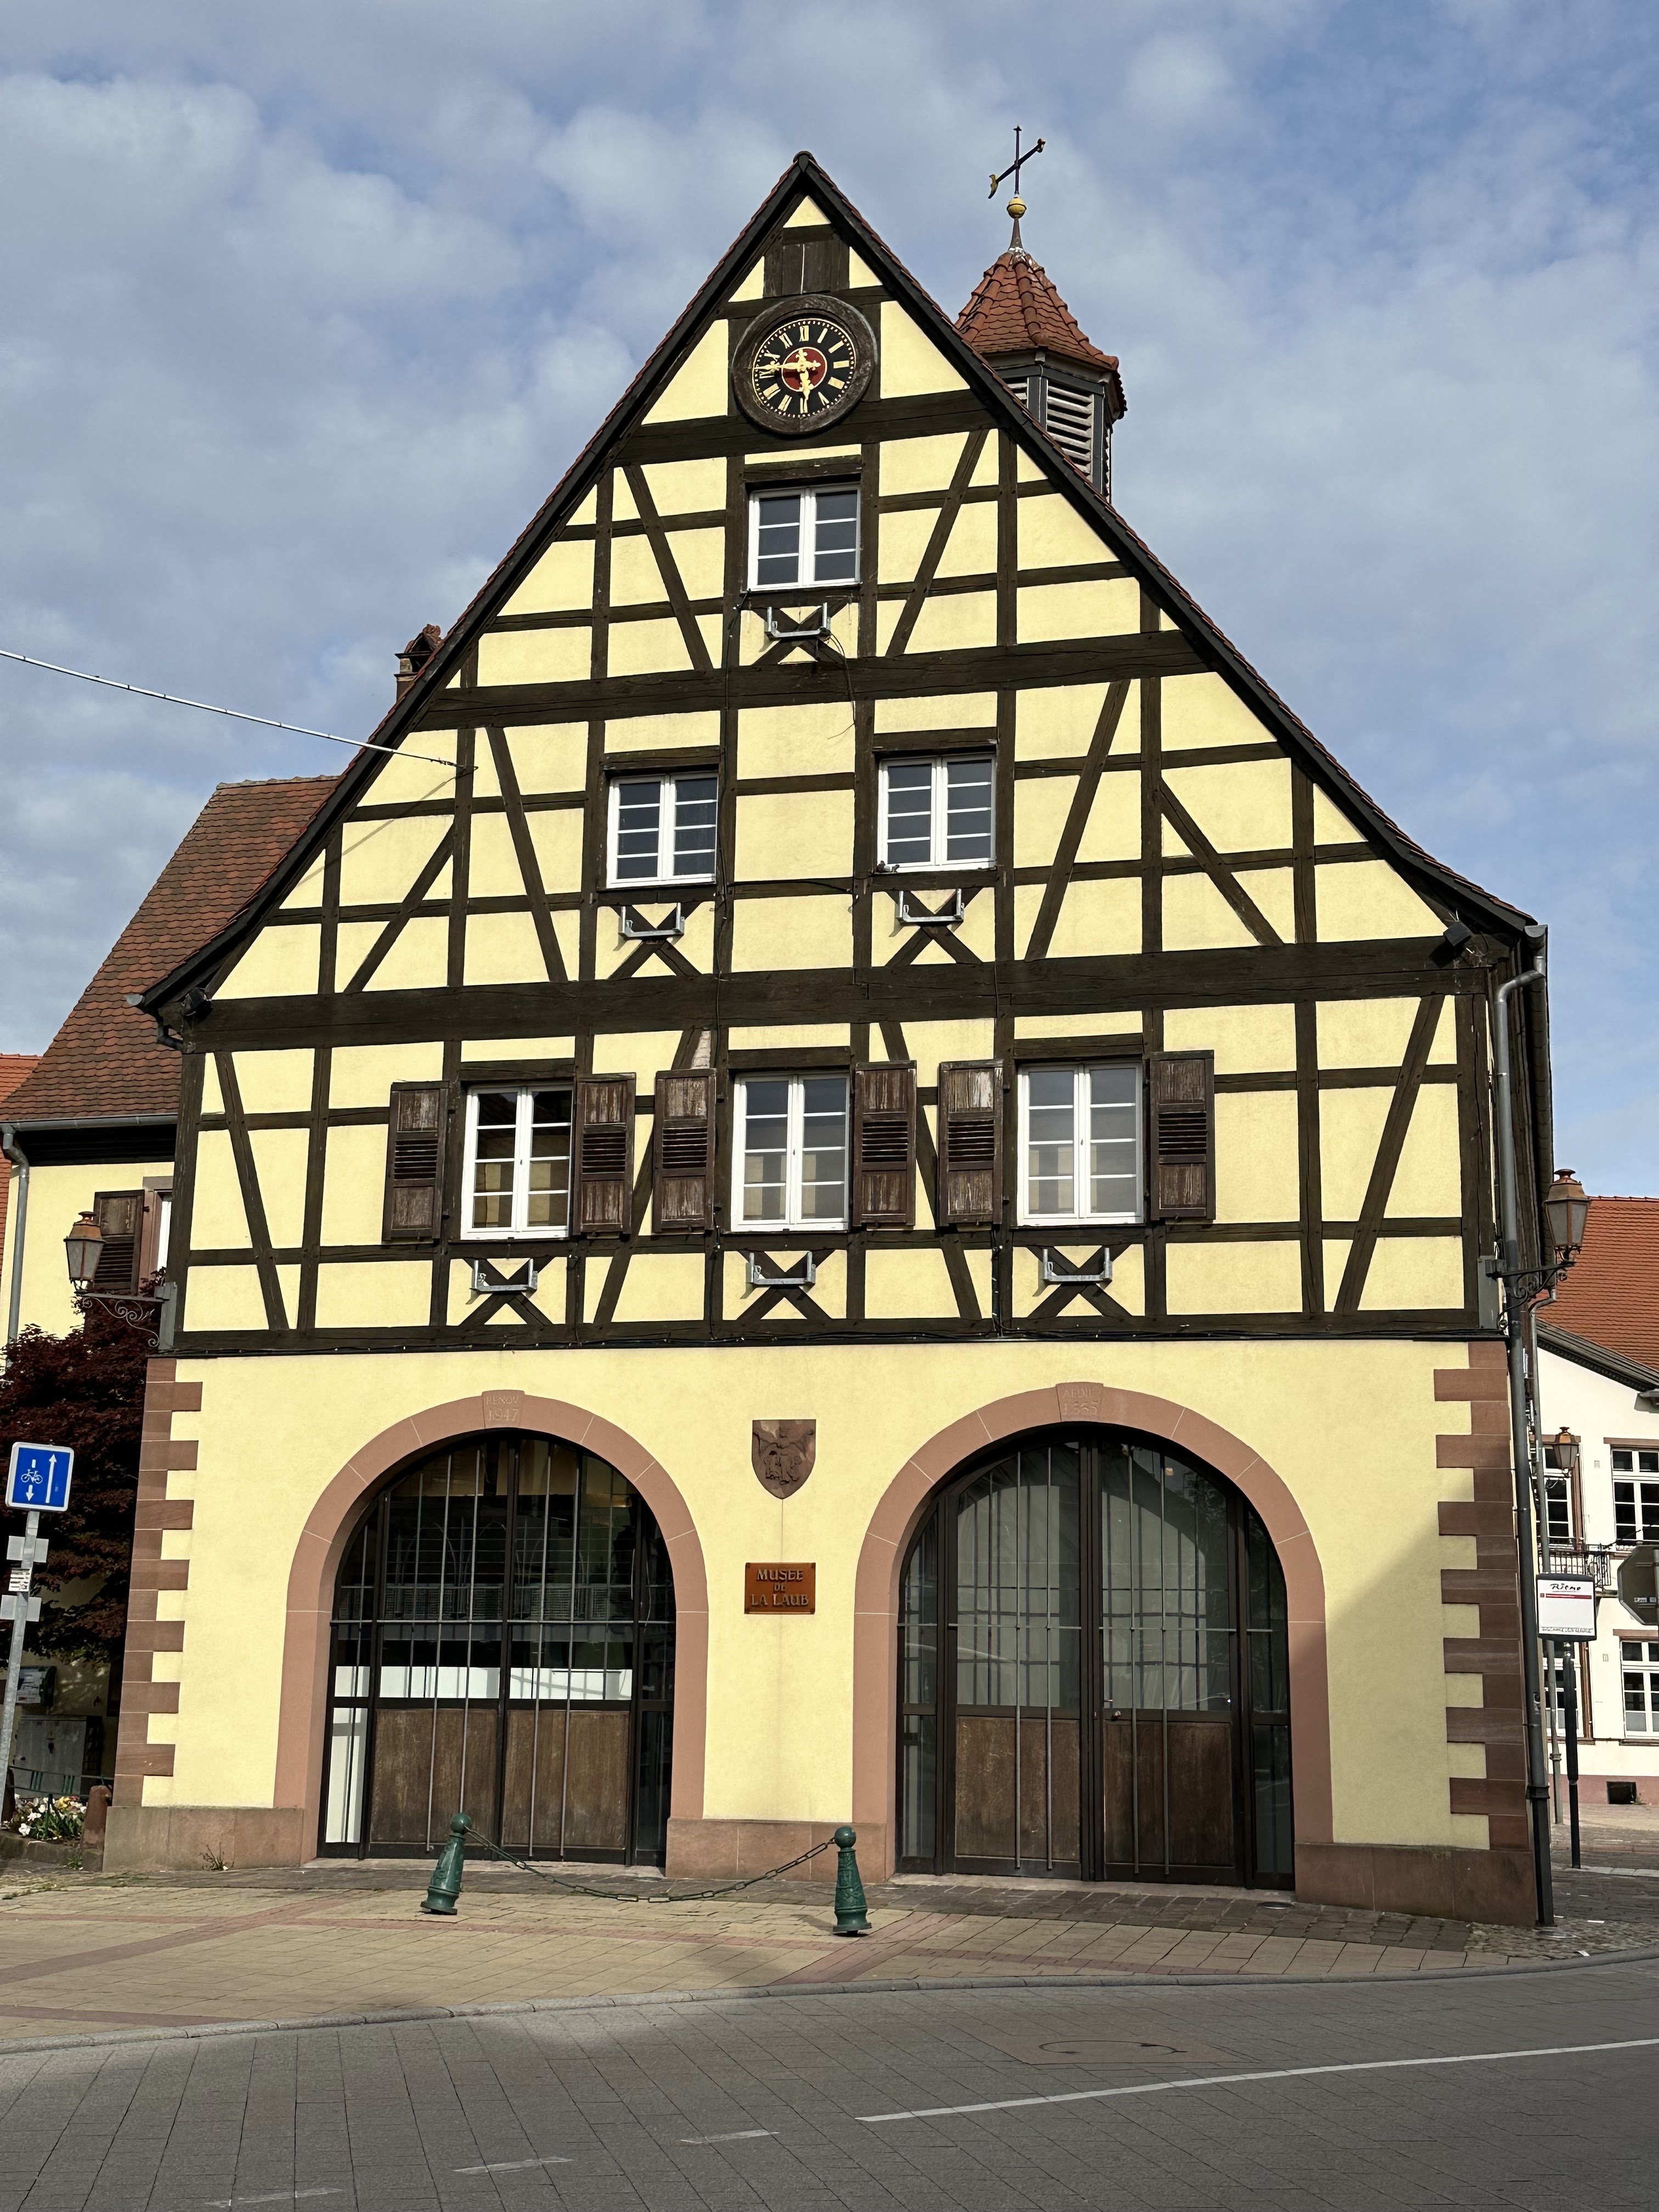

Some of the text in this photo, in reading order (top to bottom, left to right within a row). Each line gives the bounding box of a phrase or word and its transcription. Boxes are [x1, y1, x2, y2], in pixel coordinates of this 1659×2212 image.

[774, 486, 786, 494] DE
[751, 496, 809, 509] LA LAUB
